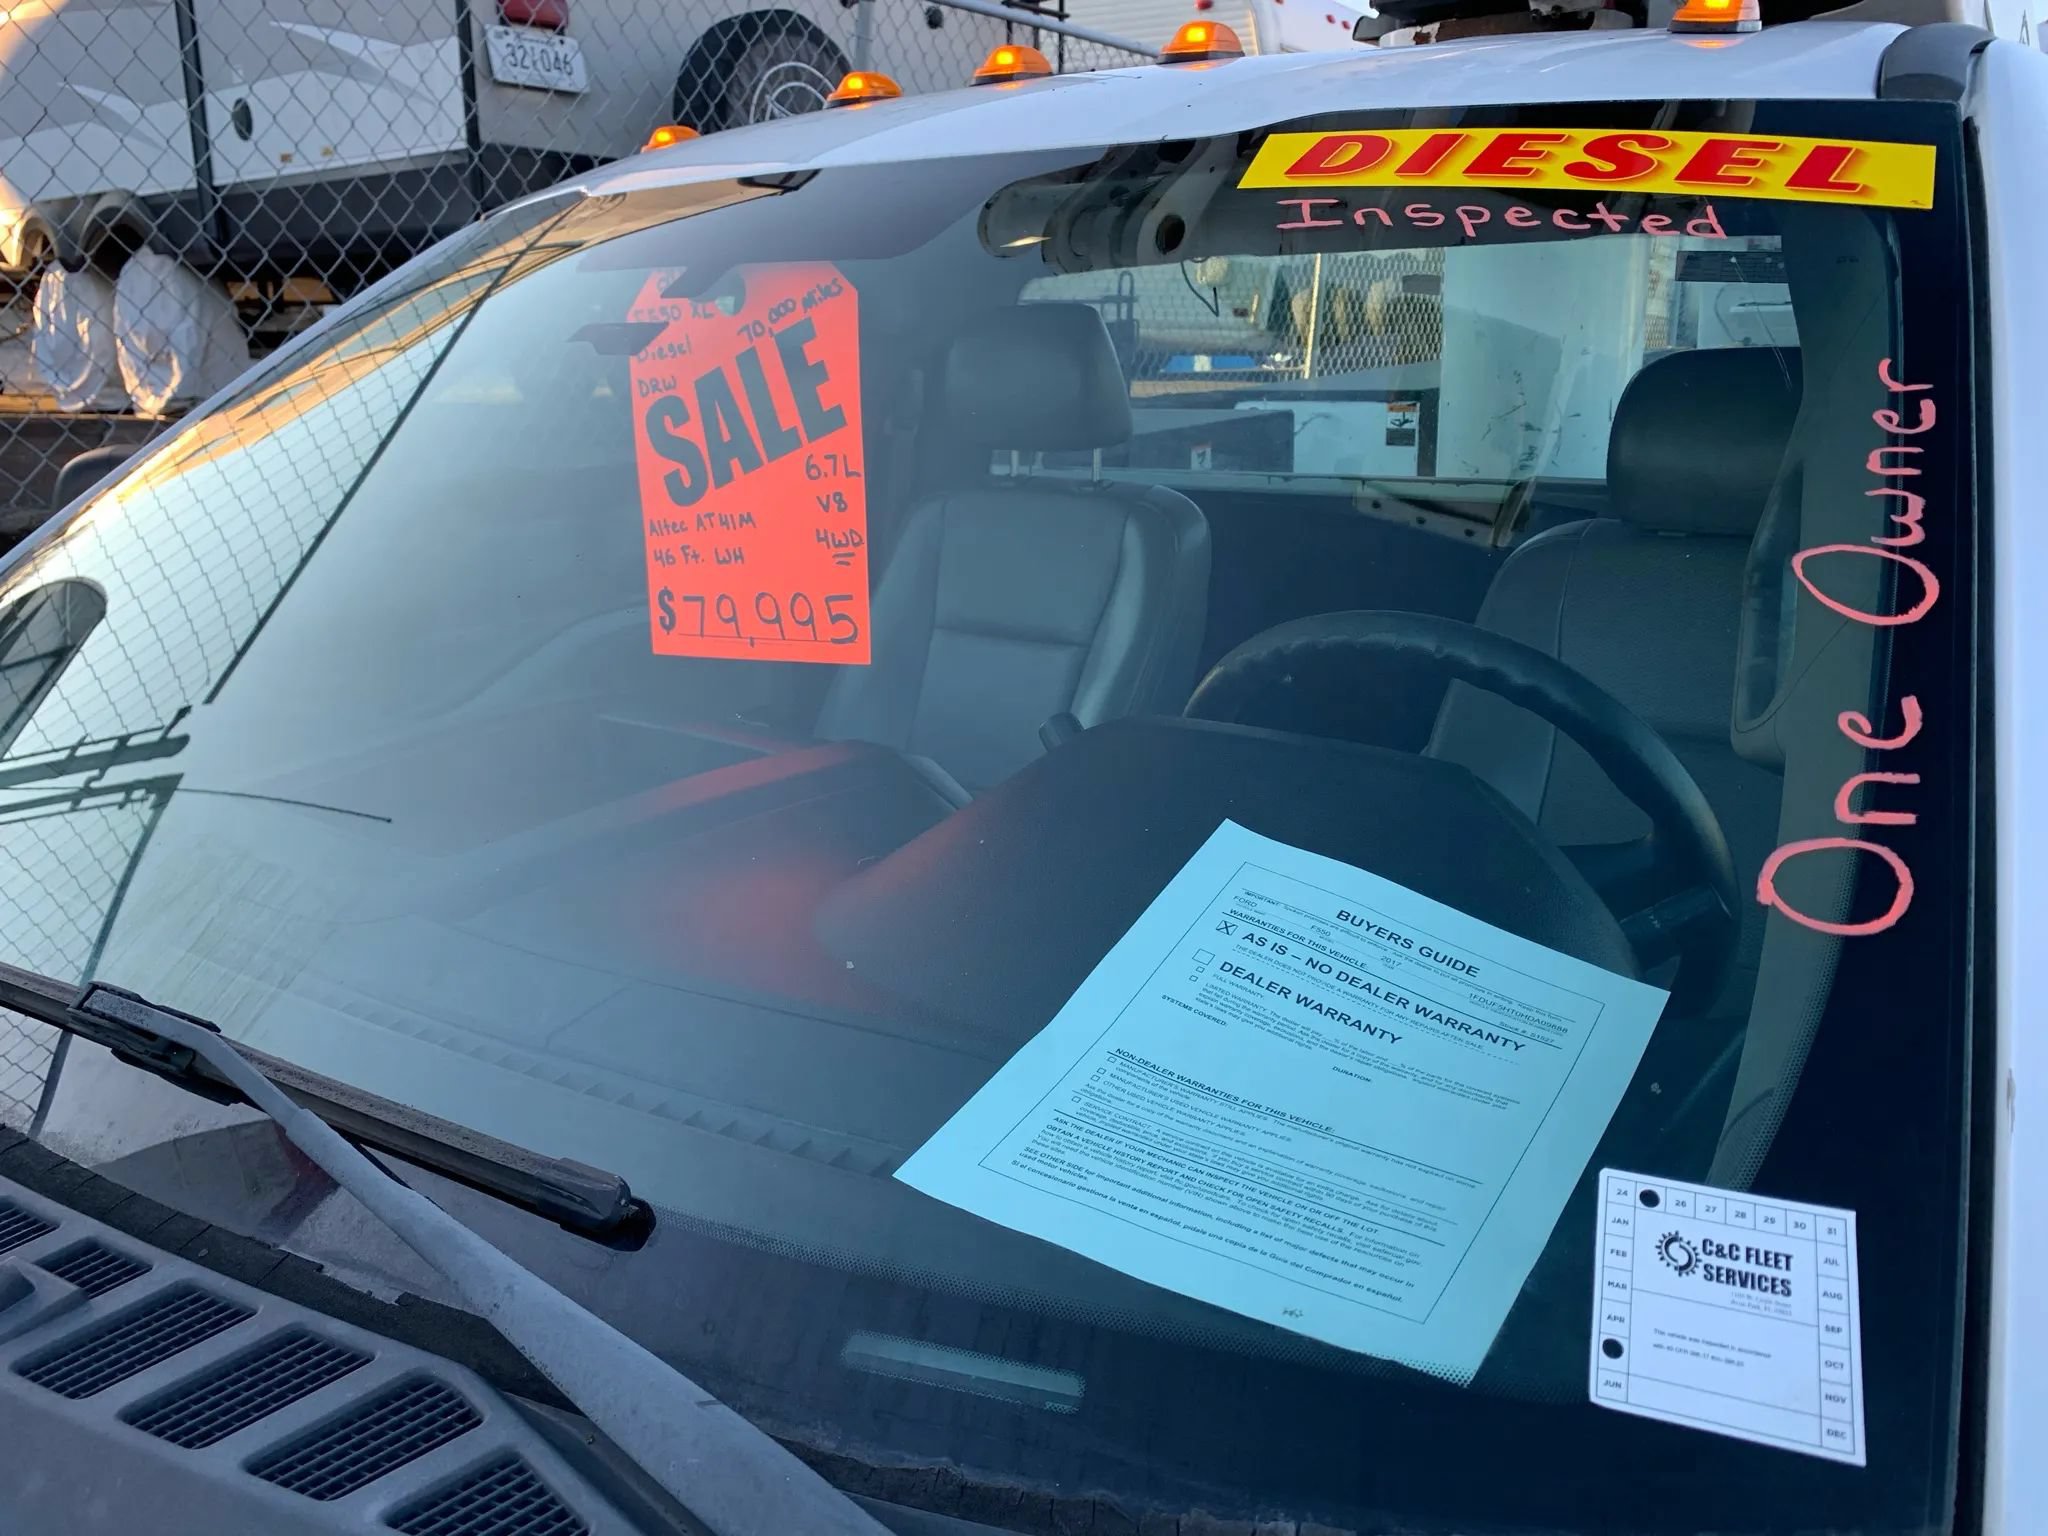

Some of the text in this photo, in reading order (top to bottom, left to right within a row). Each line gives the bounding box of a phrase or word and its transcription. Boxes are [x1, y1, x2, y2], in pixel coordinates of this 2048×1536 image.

[1283, 133, 1875, 194] DIESEL
[1276, 199, 1728, 239] Inspected
[737, 298, 797, 342] 70,000
[637, 375, 677, 397] DRW
[645, 315, 848, 507] SALE
[804, 454, 861, 481] 6.7L
[817, 492, 848, 513] V8
[815, 528, 864, 551] 4WD
[653, 548, 676, 567] 46
[658, 586, 858, 648] $79,995
[1756, 358, 1939, 936] One Owner
[1232, 895, 1258, 908] FORD
[1228, 908, 1286, 934] WARRANTIES
[1285, 931, 1307, 942] FOR
[1306, 939, 1327, 951] THIS
[1327, 948, 1368, 969] VEHICLE:
[1309, 924, 1332, 937] F550
[1335, 909, 1416, 950] BUYERS
[1416, 945, 1481, 978] GUIDE
[1379, 955, 1402, 967] 2017
[1218, 961, 1294, 999] DEALER
[1291, 993, 1403, 1045] WARRANTY
[1241, 931, 1269, 947] AS
[1268, 941, 1290, 956] IS
[1304, 957, 1334, 975] NO
[1334, 970, 1412, 1009] DEALER
[1412, 1003, 1526, 1053] WARRANTY
[1114, 1048, 1175, 1077] NON-DEALER
[1175, 1074, 1240, 1102] WARRANTIES
[1240, 1098, 1262, 1109] FOR
[1263, 1106, 1287, 1117] THIS
[1287, 1114, 1336, 1133] VEHICLE:
[1044, 1124, 1074, 1138] OBTAIN
[1080, 1137, 1113, 1152] VEHICLE
[1111, 1148, 1147, 1164] HISTORY
[1145, 1160, 1179, 1176] REPORT
[1178, 1172, 1197, 1182] AND
[1196, 1179, 1226, 1192] CHECK
[1225, 1189, 1244, 1198] FOR
[1244, 1195, 1269, 1207] OPEN
[1269, 1204, 1303, 1219] SAFETY
[1052, 1116, 1070, 1126] ASK
[1068, 1122, 1084, 1131] THE
[1084, 1128, 1116, 1143] DEALER
[1122, 1142, 1146, 1154] YOUR
[1145, 1150, 1187, 1169] MECHANIC
[1186, 1165, 1206, 1175] CAN
[1204, 1171, 1240, 1186] INSPECT
[1240, 1183, 1257, 1192] THE
[1257, 1189, 1294, 1205] VEHICLE
[1293, 1201, 1308, 1210] ON
[1308, 1206, 1323, 1215] OR
[1322, 1211, 1341, 1221] OFF
[1341, 1218, 1359, 1227] THE
[1022, 1147, 1040, 1155] SEE
[1039, 1152, 1065, 1165] OTHER
[1065, 1162, 1084, 1172] SIDE
[1083, 1168, 1096, 1176] for
[1094, 1173, 1132, 1190] important
[1130, 1186, 1169, 1203] additional
[1214, 1215, 1253, 1232] including
[1258, 1231, 1273, 1240] list
[1282, 1239, 1308, 1252] major
[1307, 1248, 1340, 1263] defects
[1339, 1259, 1358, 1269] that
[1358, 1265, 1377, 1275] may
[1377, 1272, 1404, 1284] occur
[1404, 1280, 1416, 1288] in
[1611, 1217, 1630, 1227] JAN
[1675, 1198, 1687, 1208] 26
[1705, 1204, 1717, 1214] 27
[1734, 1210, 1747, 1219] 28
[1763, 1215, 1776, 1225] 29
[1793, 1221, 1806, 1231] 30
[1827, 1227, 1837, 1236] 31
[1610, 1248, 1628, 1258] FEB
[1702, 1238, 1793, 1272] C&C FLEET
[1823, 1256, 1840, 1267] JUL
[1607, 1280, 1627, 1291] MAR
[1703, 1264, 1792, 1298] SERVICES
[1822, 1290, 1843, 1301] AUG
[1606, 1314, 1625, 1324] APR
[1824, 1325, 1843, 1335] SEP
[1824, 1360, 1844, 1371] OCT
[1603, 1379, 1622, 1390] JUN
[1824, 1393, 1847, 1404] NOV
[1826, 1429, 1847, 1440] DEC
